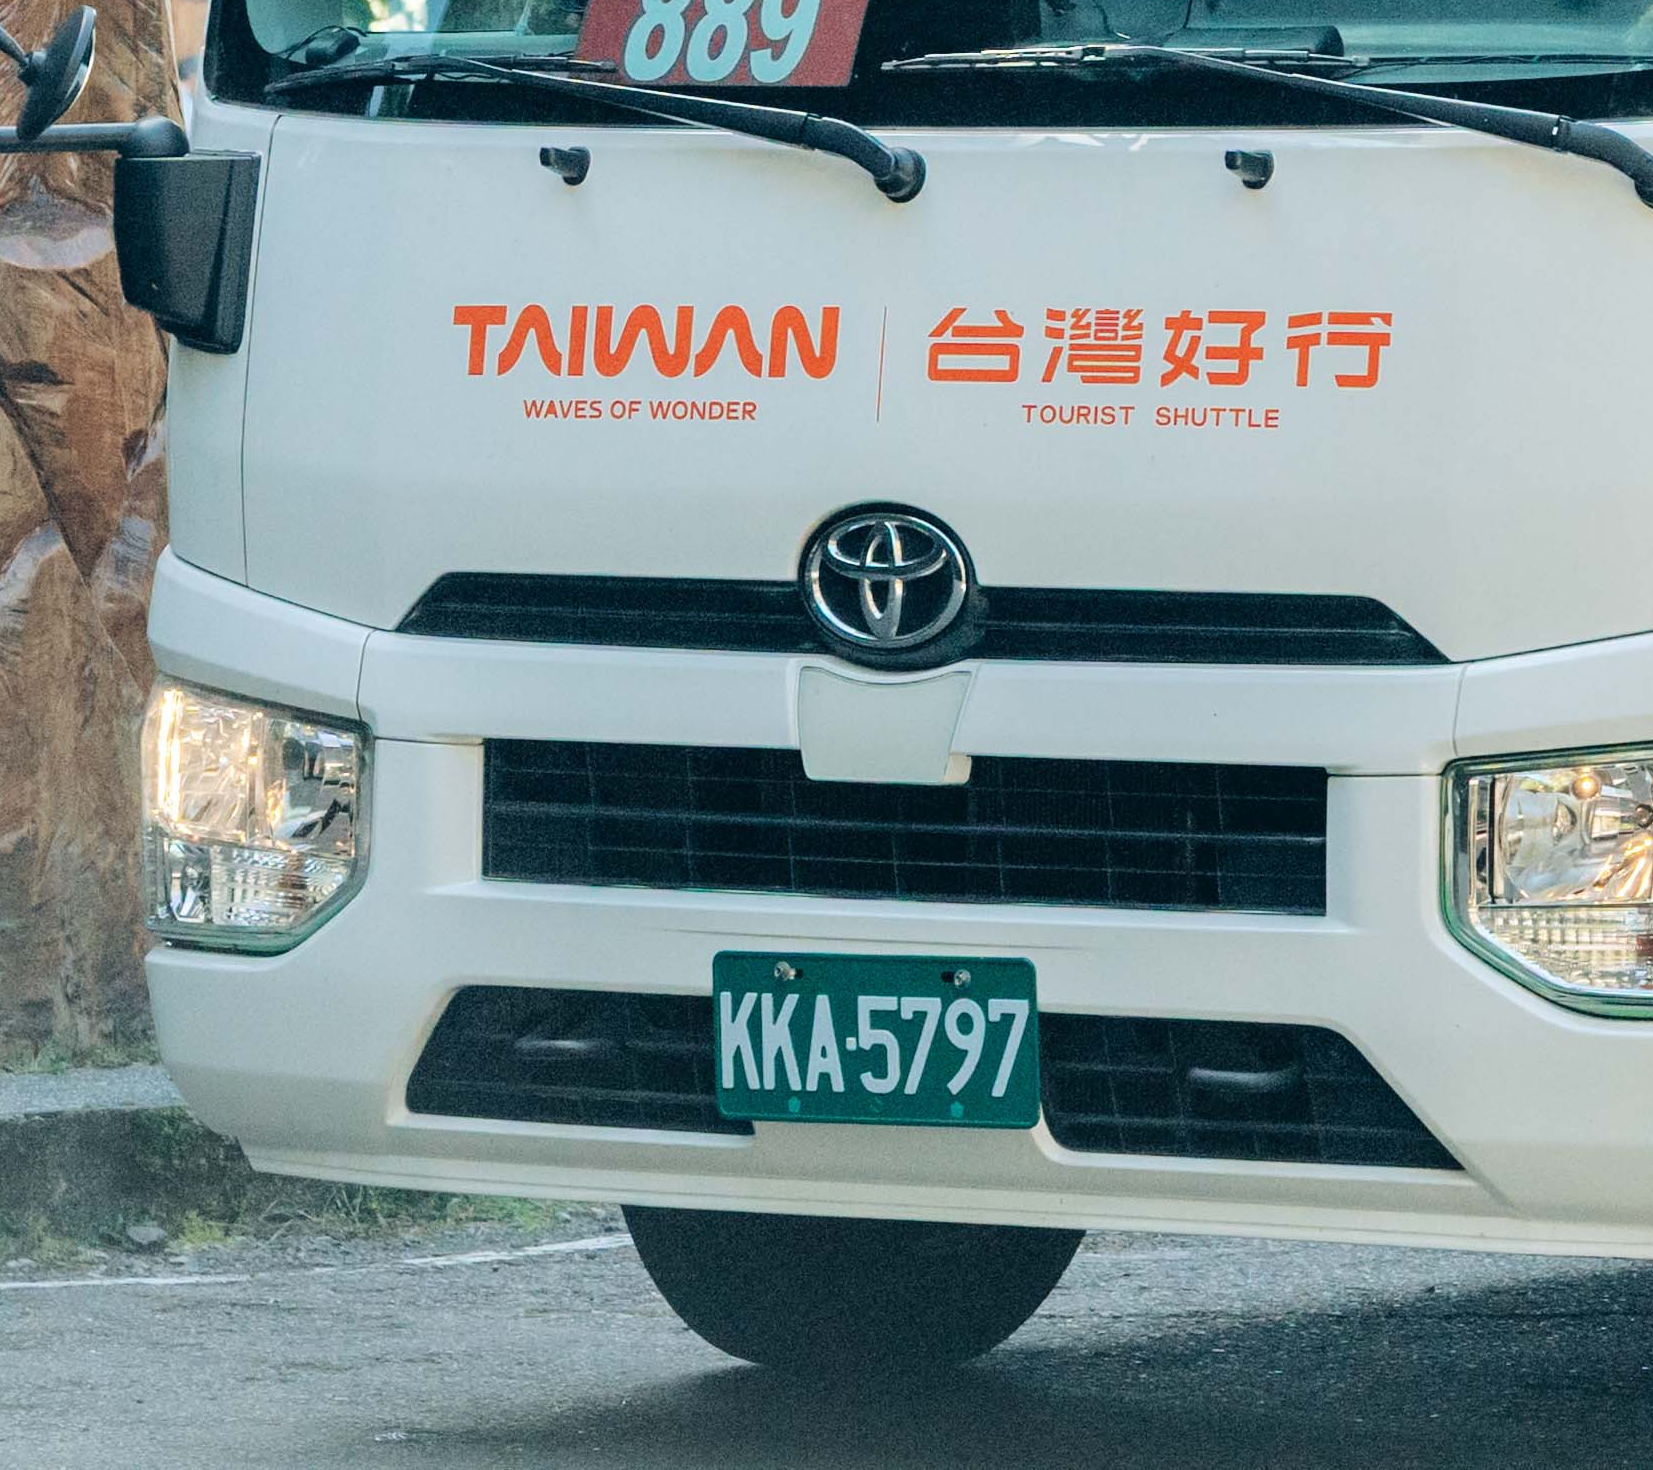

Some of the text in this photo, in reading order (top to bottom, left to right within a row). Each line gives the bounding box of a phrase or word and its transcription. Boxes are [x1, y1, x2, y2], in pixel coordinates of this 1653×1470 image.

[453, 304, 841, 380] TAIWAN
[927, 306, 1394, 389] 台灣好行
[523, 399, 758, 422] WAVES OF WONDER
[1022, 404, 1280, 429] TOURIST SHUTTLE
[719, 991, 1030, 1098] KKA-5797
